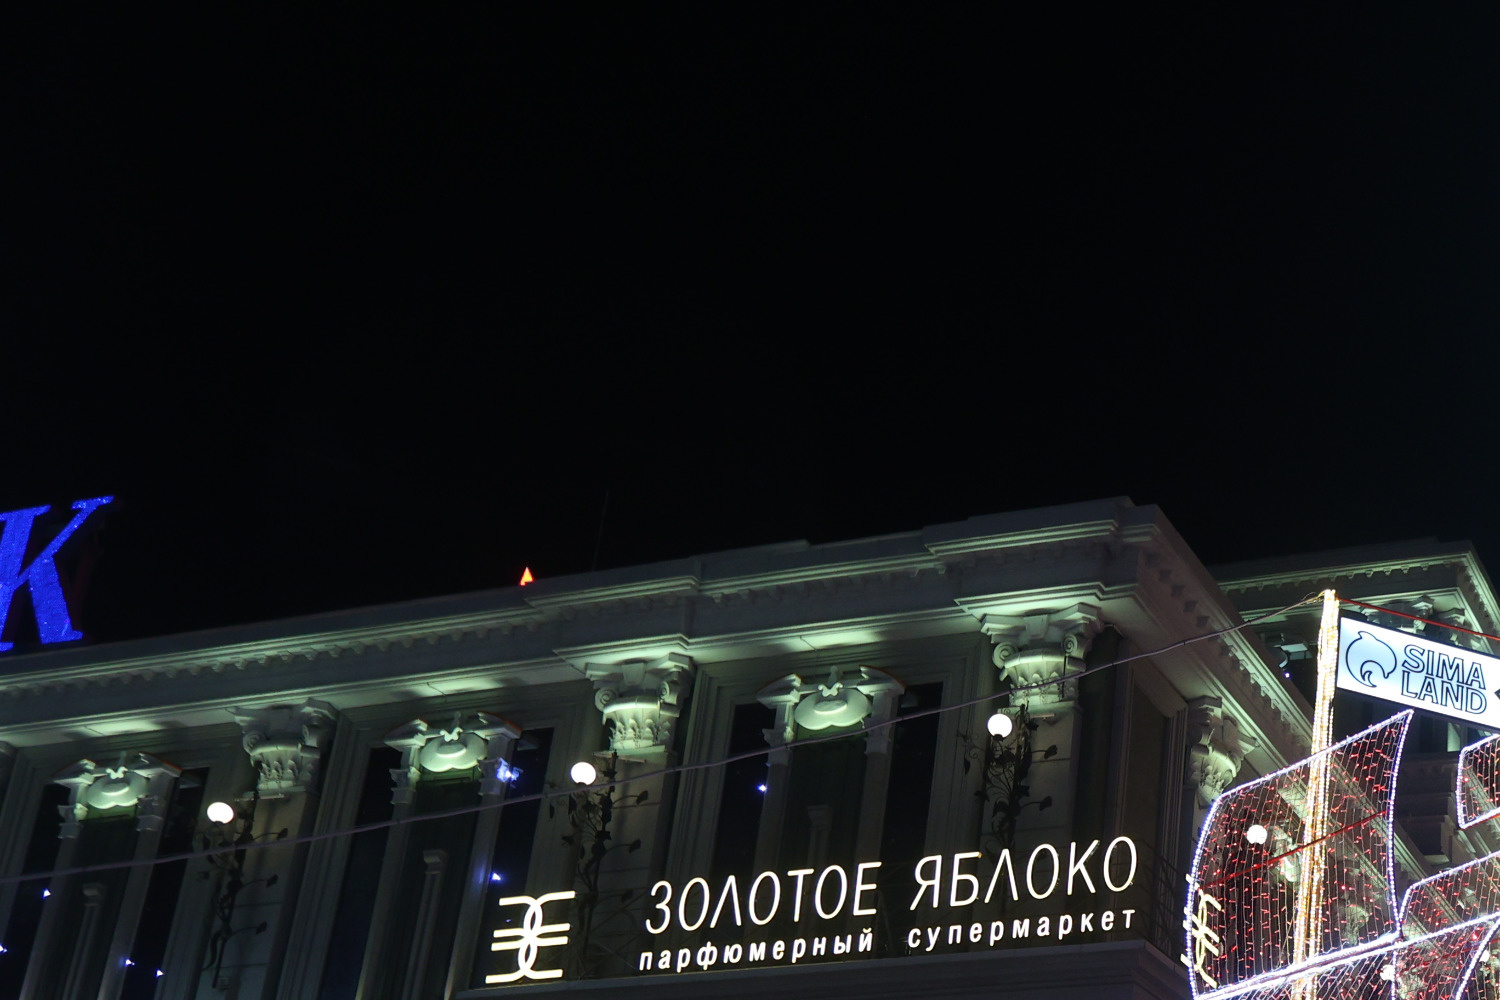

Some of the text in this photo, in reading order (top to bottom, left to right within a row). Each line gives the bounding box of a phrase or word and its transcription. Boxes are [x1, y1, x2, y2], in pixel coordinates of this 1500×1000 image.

[1401, 671, 1487, 715] LAND
[1402, 644, 1487, 690] SIMA
[645, 836, 1138, 935] ЗОЛОТОЕ ЯБЛОКО
[639, 905, 1136, 972] парфюмерный супермаркет
